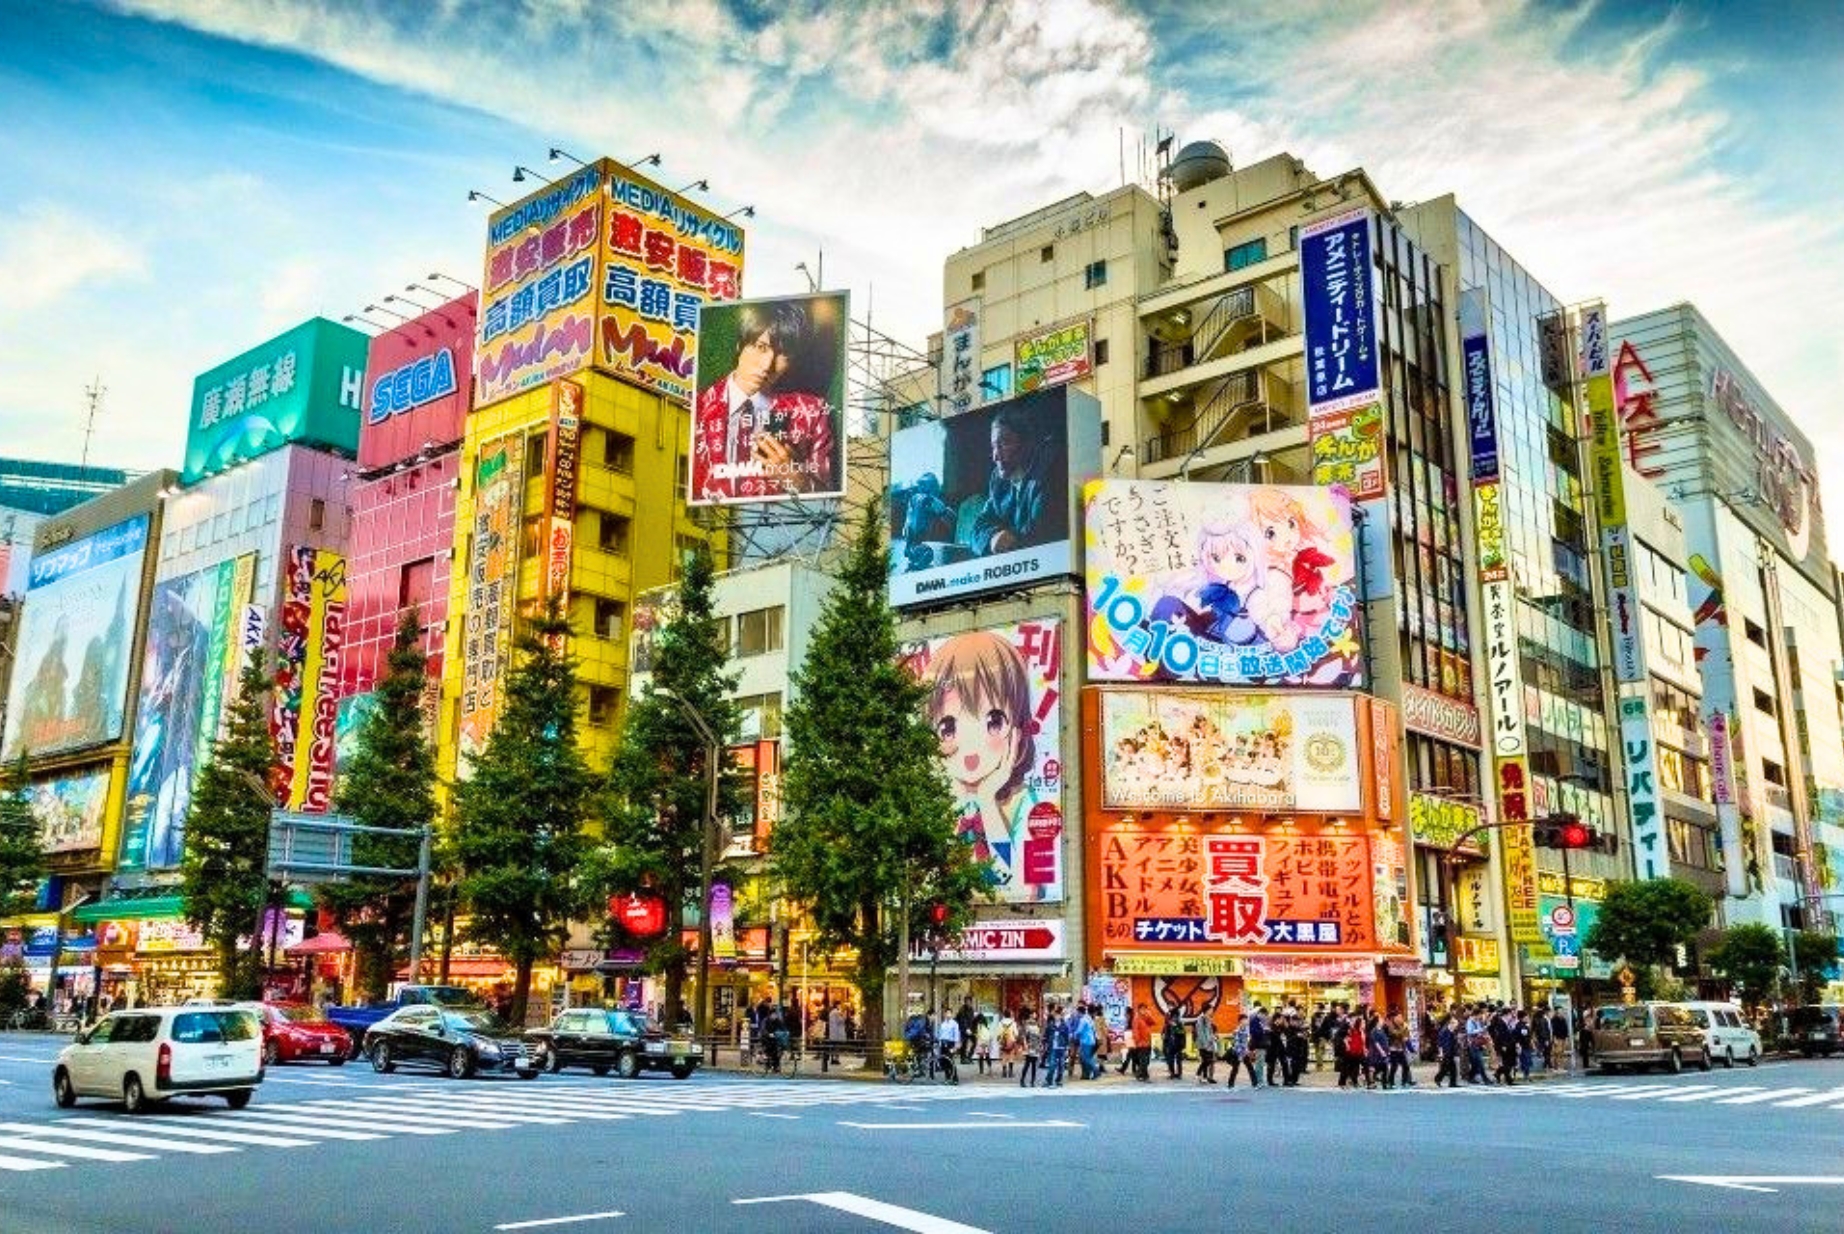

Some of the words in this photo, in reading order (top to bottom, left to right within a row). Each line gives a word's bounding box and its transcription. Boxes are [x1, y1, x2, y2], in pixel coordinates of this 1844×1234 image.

[484, 256, 593, 344] 高額買取
[604, 264, 697, 330] 高額買
[369, 347, 457, 425] SEGA
[983, 558, 1040, 580] ROBOTS
[1111, 788, 1184, 803] Welcome
[1135, 837, 1156, 914] アイドル
[1156, 837, 1177, 893] アニメ
[1178, 837, 1201, 918] 美少女系
[1208, 840, 1266, 940] 買取
[1273, 840, 1294, 919] フィギュア
[1294, 840, 1315, 896] ホビー
[1316, 840, 1341, 919] 携帯電話
[1341, 841, 1366, 945] アップルとか
[1000, 930, 1025, 948] ZIN
[1274, 922, 1338, 942] 大黒屋
